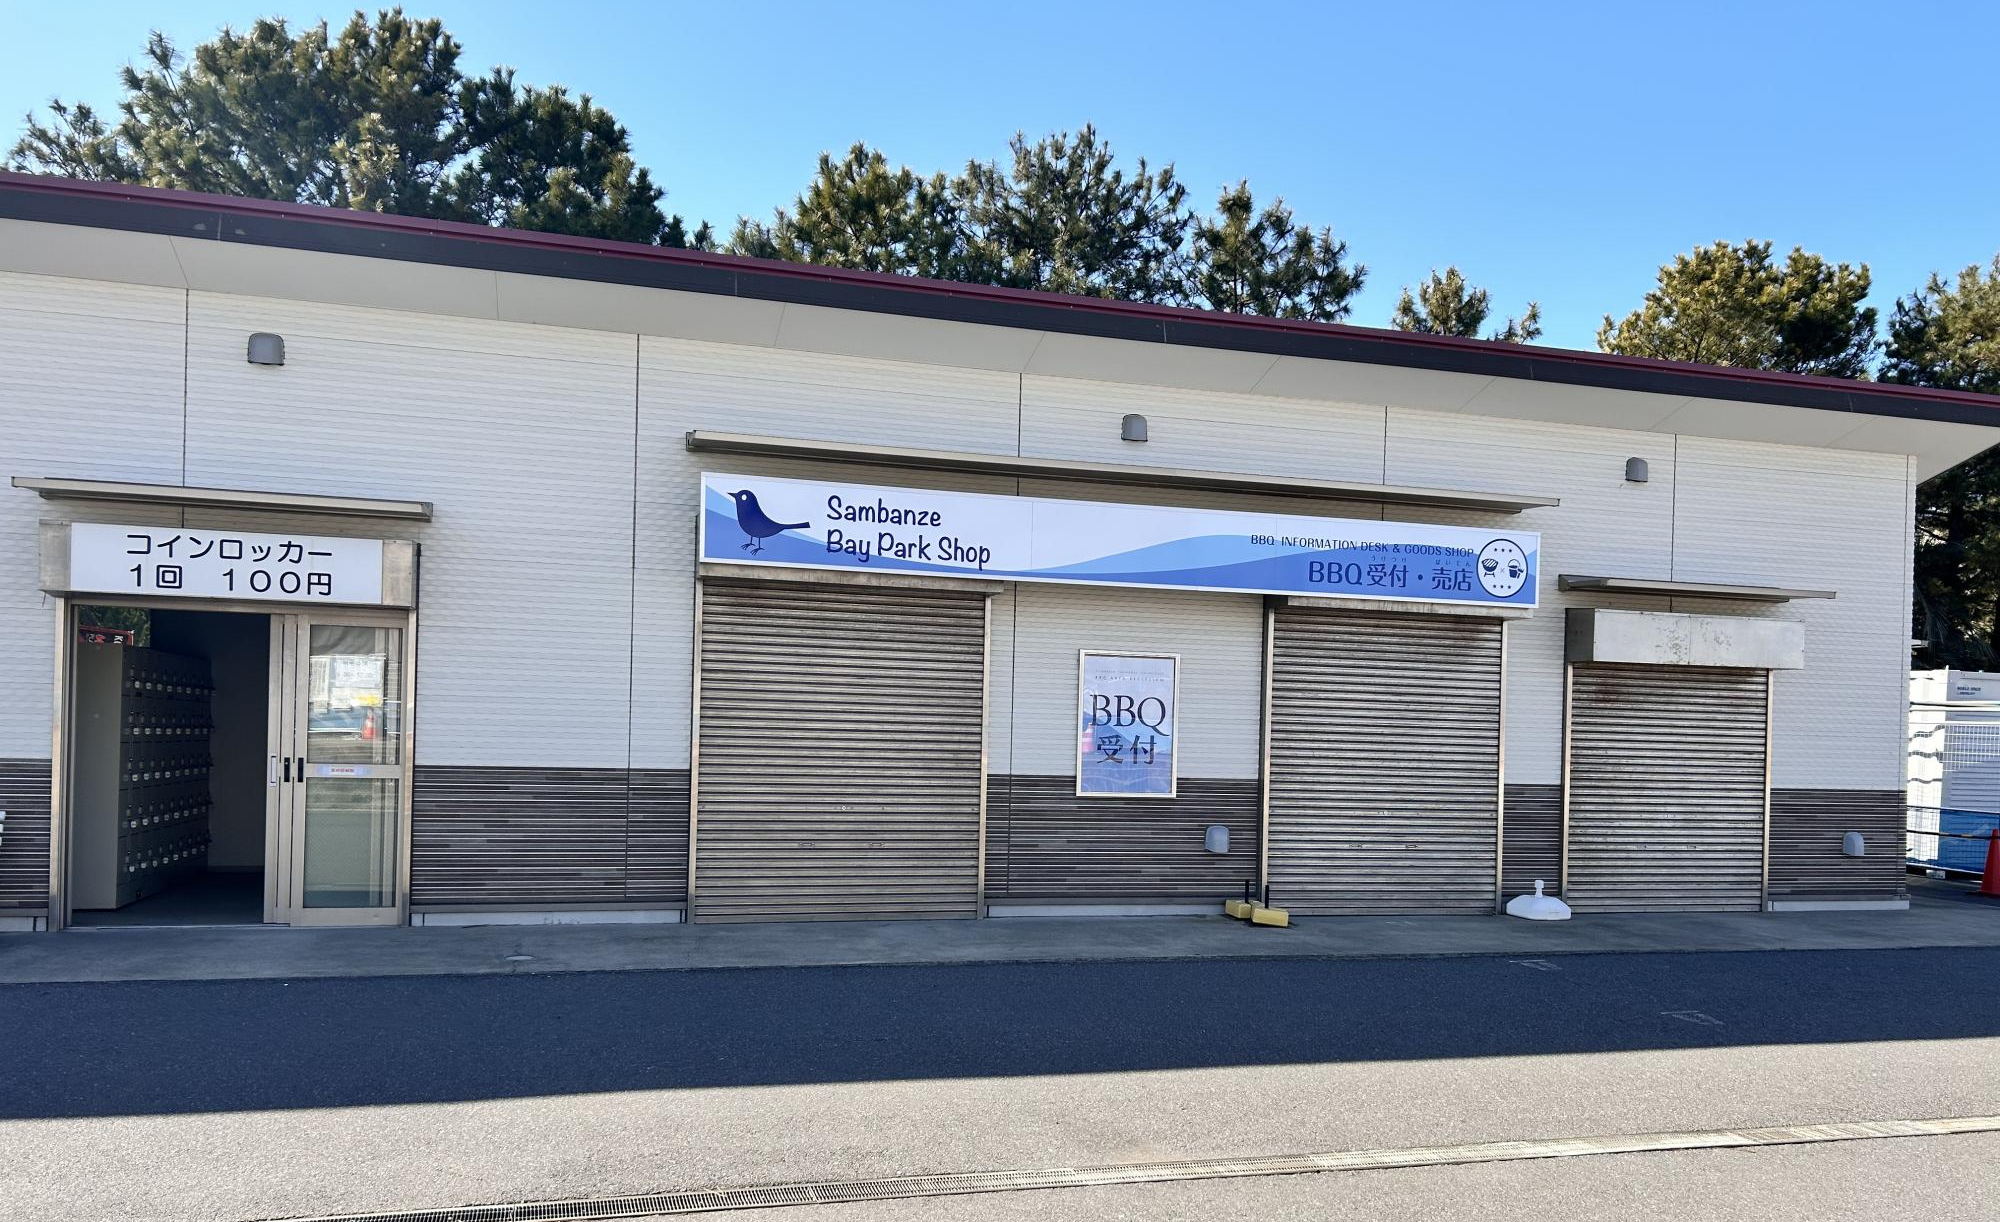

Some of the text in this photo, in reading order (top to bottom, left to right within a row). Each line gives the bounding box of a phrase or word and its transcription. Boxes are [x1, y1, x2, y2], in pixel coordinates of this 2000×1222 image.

[826, 495, 942, 527] Sambanze
[127, 534, 333, 564] コインロッカー
[826, 529, 991, 571] Bay Park Shop
[1250, 534, 1474, 558] BBQ INFORMATION DESK & GOODS SHOP
[130, 563, 332, 596] 1回 100円
[1089, 694, 1170, 737] BBQ
[1097, 734, 1157, 765] 受付
